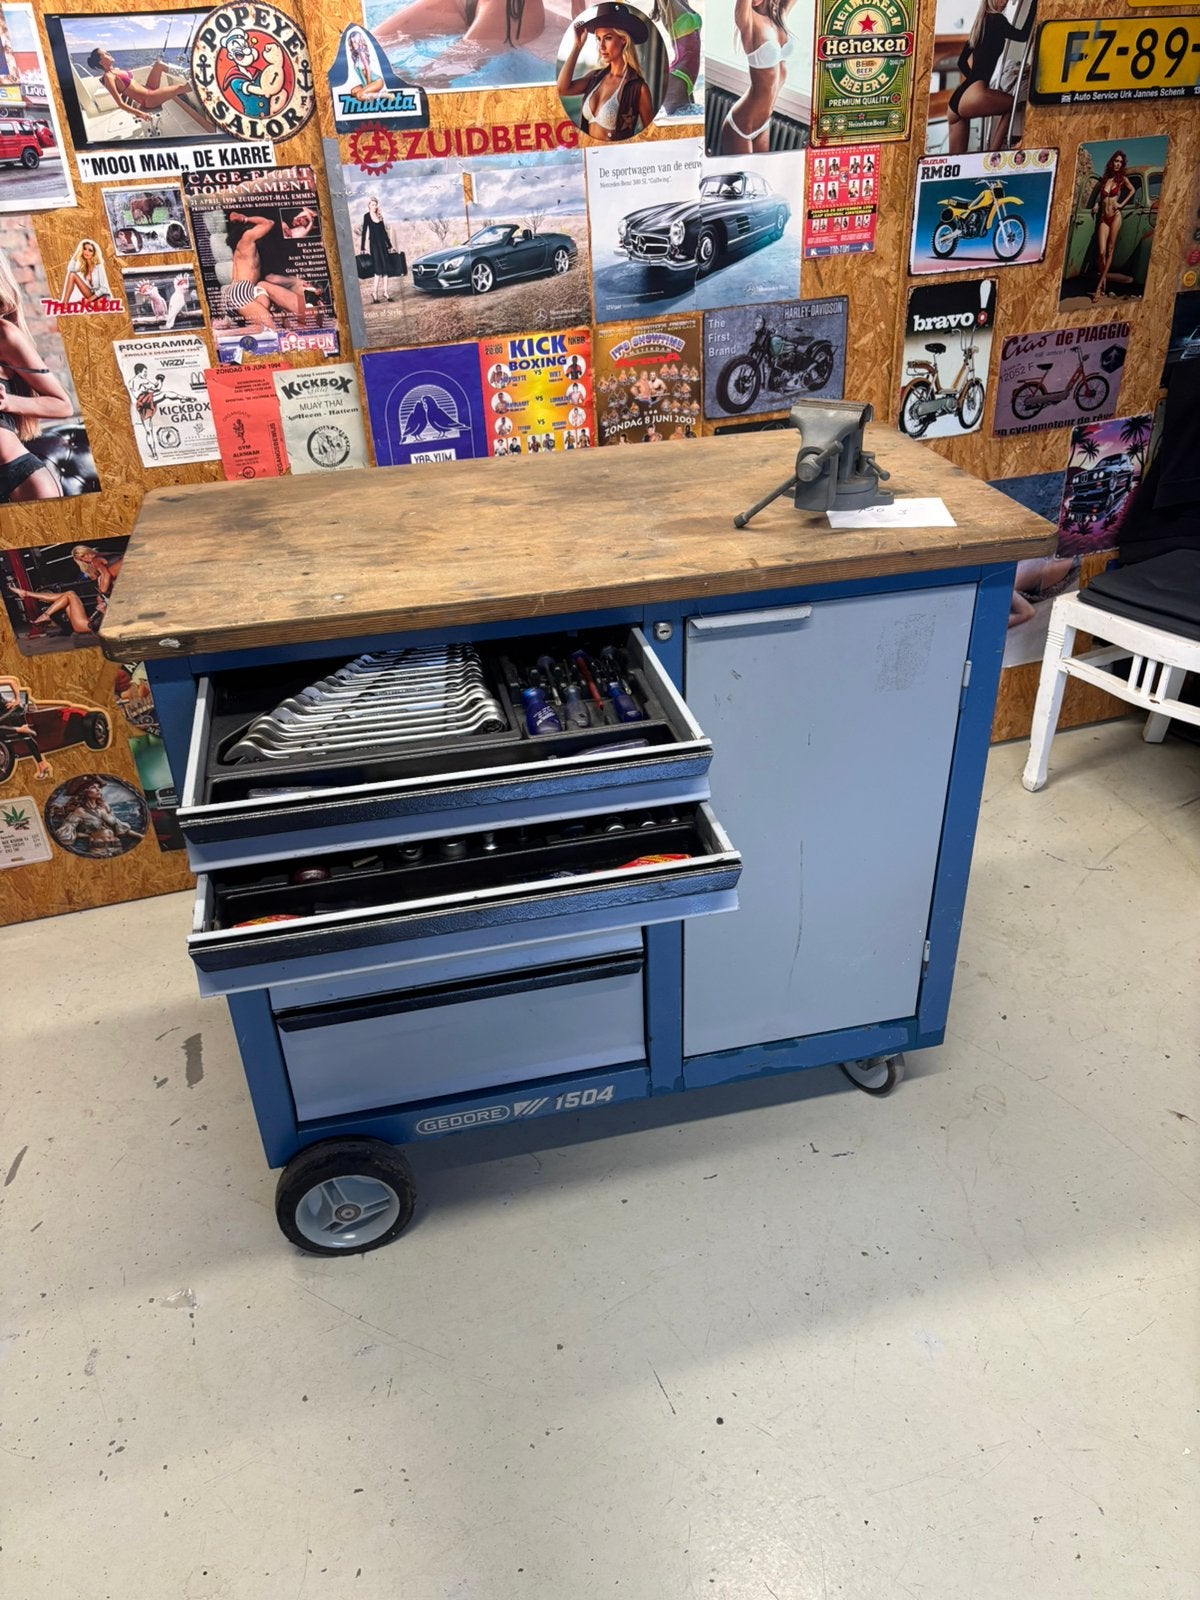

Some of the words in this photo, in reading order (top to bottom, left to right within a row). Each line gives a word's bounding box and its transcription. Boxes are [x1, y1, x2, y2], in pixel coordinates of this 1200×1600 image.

[200, 6, 305, 57] POPEYE
[828, 99, 861, 107] PREMIUM
[862, 97, 889, 105] QUALITY
[1073, 93, 1091, 101] Auto
[1092, 91, 1118, 100] Service
[1120, 90, 1132, 99] Urk
[1133, 89, 1158, 98] Jannes
[1160, 87, 1185, 97] Schenk
[212, 101, 303, 139] SALOR
[402, 121, 579, 160] ZUIDBERG
[194, 150, 215, 169] DE
[220, 145, 271, 166] KARRE
[189, 167, 310, 184] CAGE-FIGHT
[599, 167, 610, 178] De
[612, 165, 655, 179] sportwagen
[658, 163, 671, 173] van
[673, 161, 682, 171] de
[921, 164, 960, 180] RM80
[190, 180, 311, 195] TOURNAMENT
[41, 296, 123, 315] makita
[784, 301, 843, 319] HARLEY-DAVIDSON
[708, 319, 726, 329] The
[913, 312, 974, 331] bravo
[309, 336, 334, 350] FUN
[708, 333, 730, 343] First
[1056, 330, 1073, 346] de
[1076, 323, 1130, 343] PIAGGIO
[119, 339, 202, 352] PROGRAMMA
[509, 335, 567, 359] KICK
[708, 346, 736, 357] Brand
[509, 355, 567, 371] BOXING
[159, 402, 211, 416] KICKBOX
[300, 401, 322, 411] MUAY
[325, 399, 343, 408] THAI
[171, 412, 203, 423] GALA
[605, 418, 643, 437] ZONDAG
[645, 416, 649, 424] 8
[652, 415, 672, 424] JUNI
[675, 415, 696, 425] 2003
[1010, 417, 1075, 435] cyclomoteur
[424, 1109, 503, 1131] GEDORE
[556, 1085, 614, 1110] 1504
